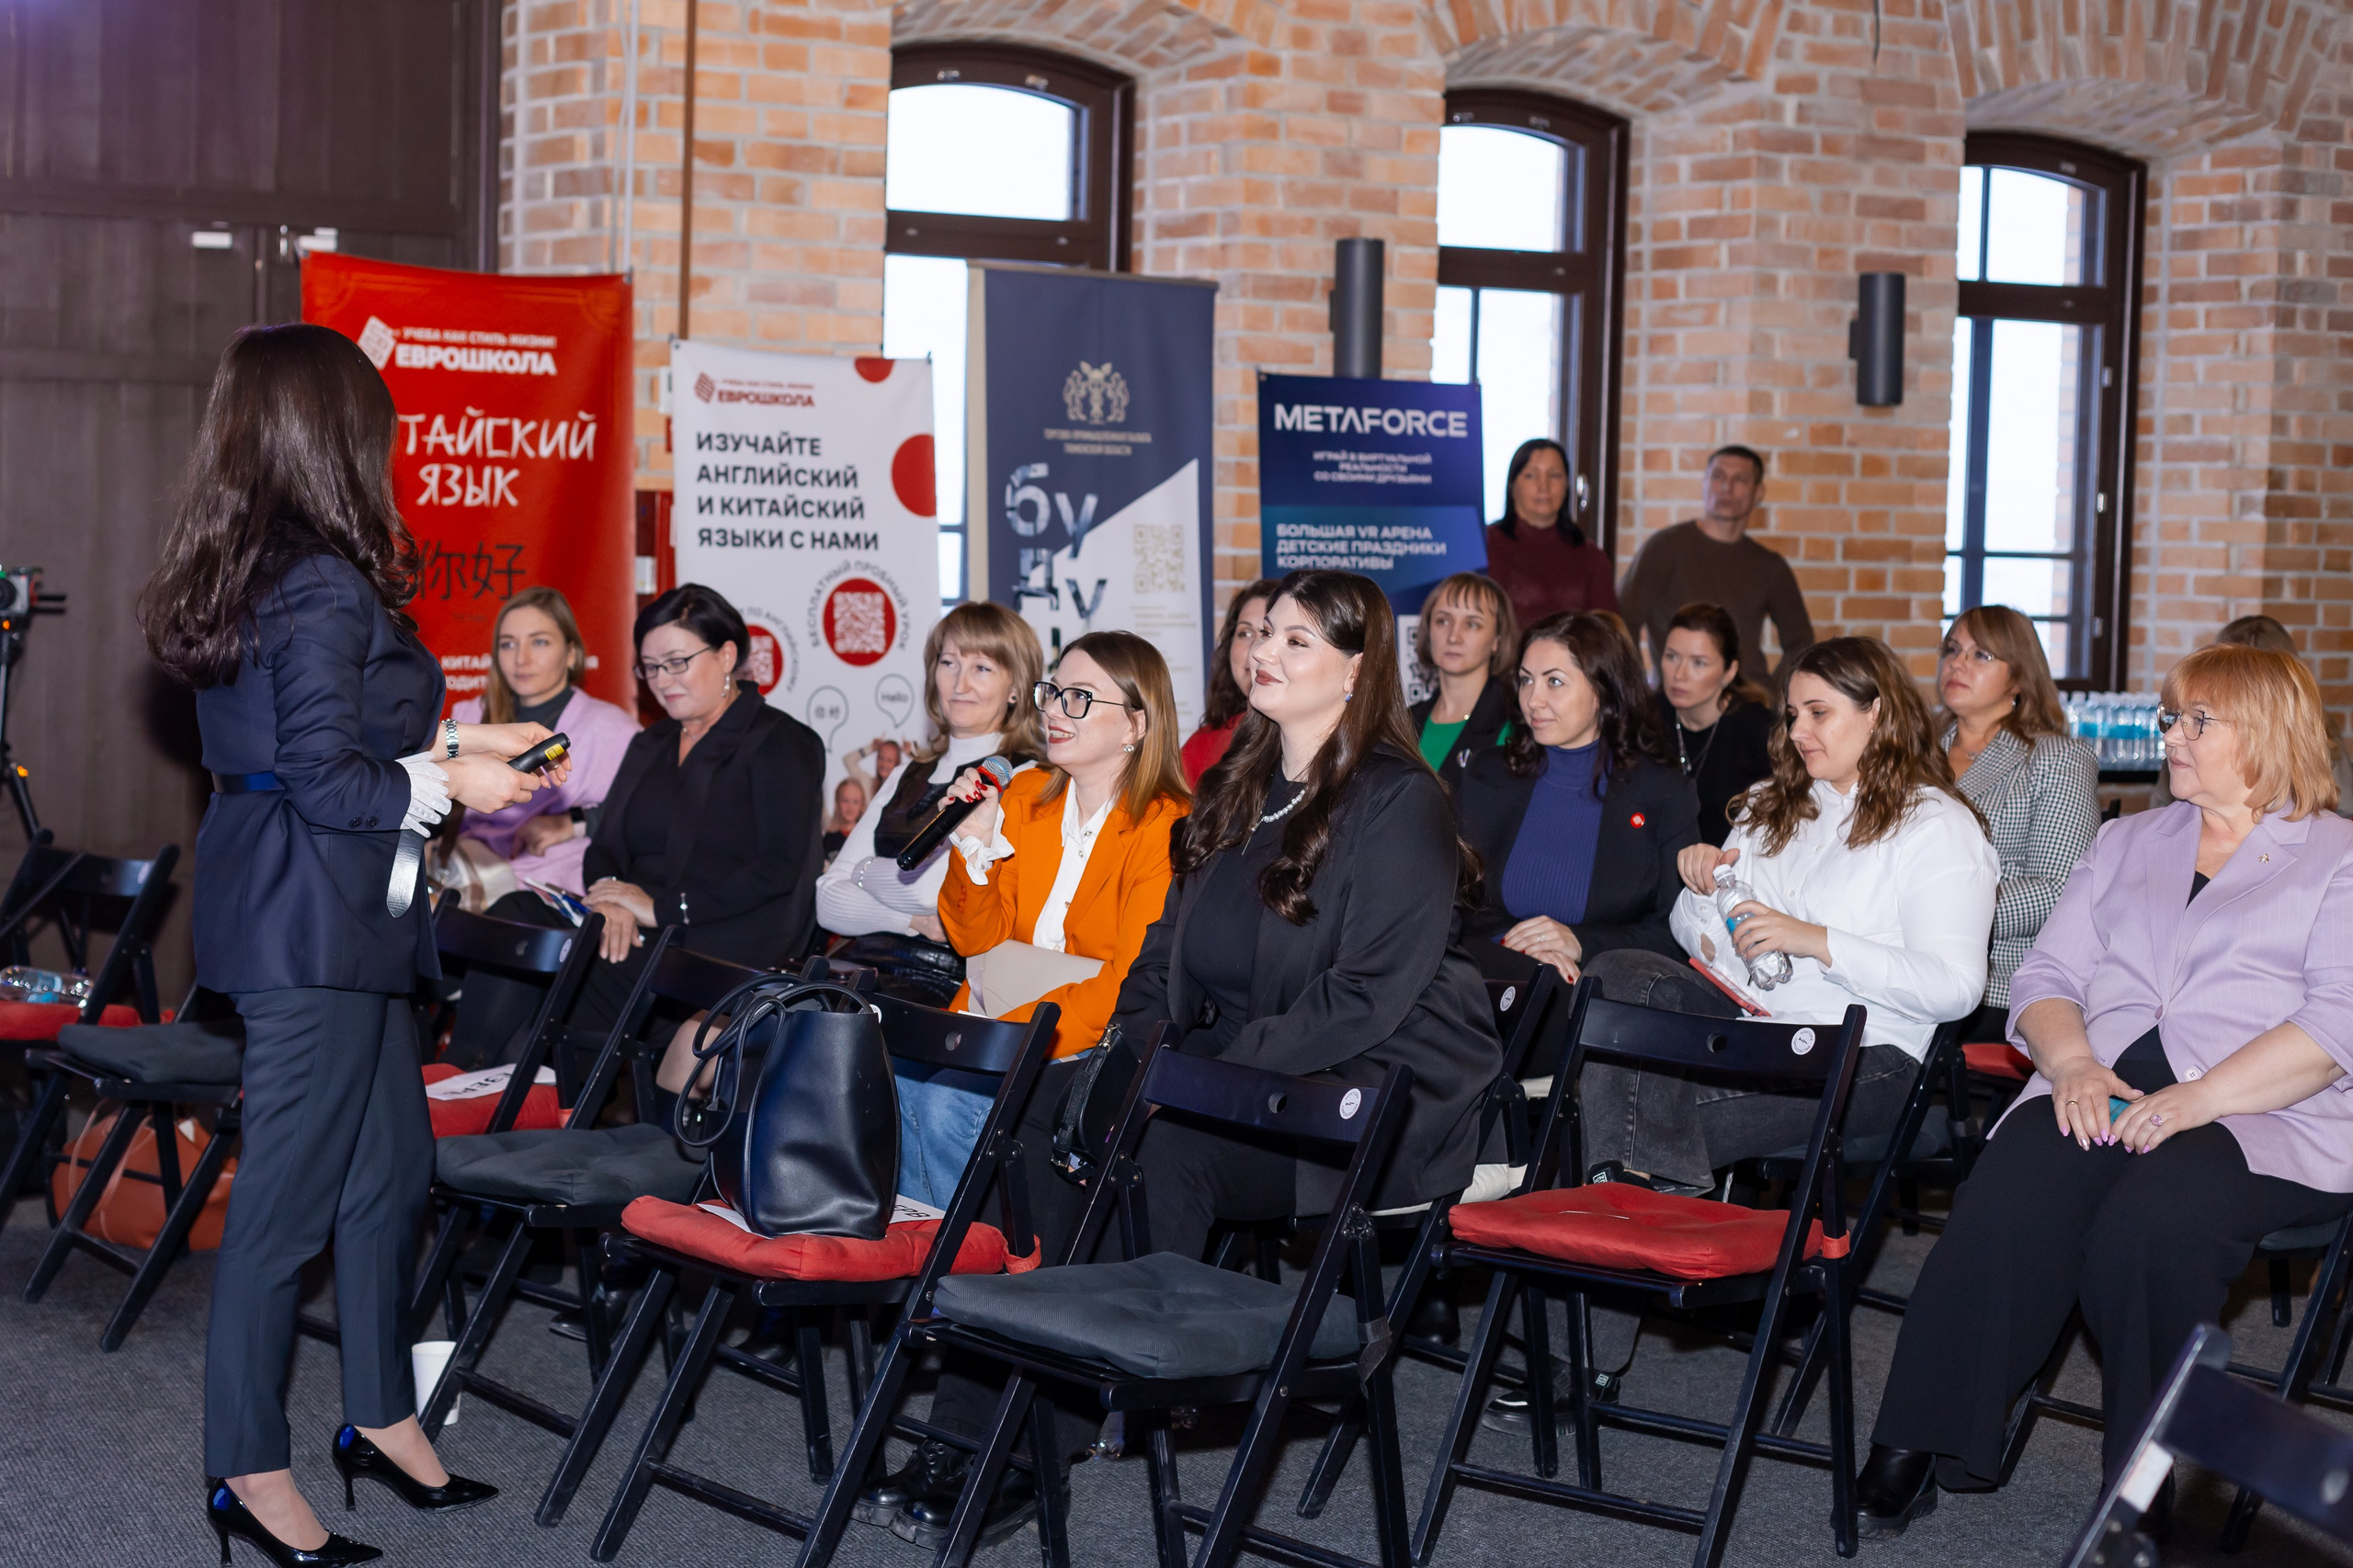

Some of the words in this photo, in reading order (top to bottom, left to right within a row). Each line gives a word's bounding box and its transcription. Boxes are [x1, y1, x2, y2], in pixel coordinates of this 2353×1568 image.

[395, 344, 557, 375] ЕВРОШКОЛА
[718, 390, 814, 407] ЕВРОШКОЛА
[399, 406, 597, 461] ТАЙСКИЙ
[696, 431, 822, 457] ИЗУЧАЙТЕ
[416, 464, 520, 507] ЯЗЫК
[696, 463, 858, 489] АНГЛИЙСКИЙ
[698, 497, 713, 516] И
[720, 494, 865, 520] КИТАЙСКИЙ
[698, 528, 784, 550] ЯЗЫКИ
[790, 530, 805, 550] С
[810, 531, 880, 551] НАМИ
[1277, 524, 1356, 539] БОЛЬШАЯ
[1358, 525, 1379, 539] VR
[1381, 526, 1433, 540] АРЕНА
[1276, 539, 1348, 554] ДЕТСКИЕ
[1351, 540, 1447, 555] ПРАЗДНИКИ
[1277, 555, 1393, 570] КОРПОРАТИВЫ
[807, 559, 851, 648] БЕСПЛАТНЫЙ
[854, 561, 910, 608] ПРОБНЫЙ
[897, 611, 912, 651] УРОК
[441, 654, 493, 669] КИТАЙ
